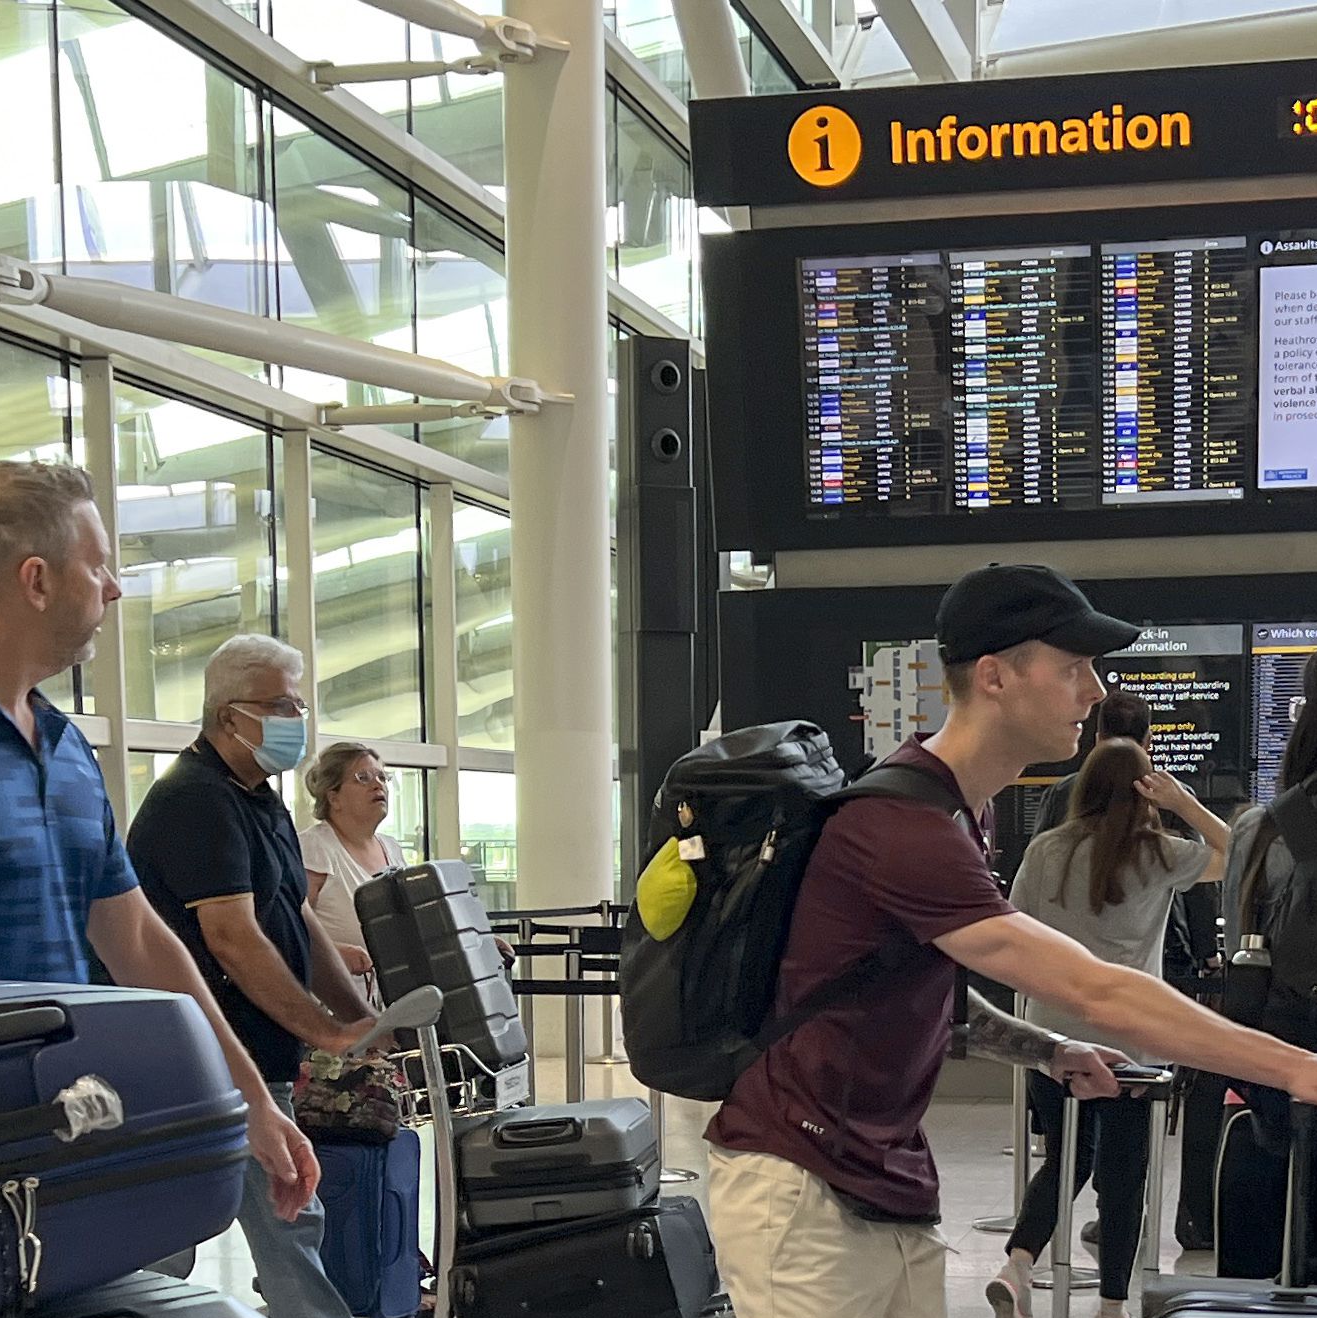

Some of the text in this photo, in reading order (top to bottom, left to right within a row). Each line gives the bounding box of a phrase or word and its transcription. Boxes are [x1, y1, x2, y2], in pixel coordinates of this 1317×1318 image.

[890, 104, 1192, 164] Information
[1274, 290, 1307, 301] Please
[1274, 304, 1303, 314] when
[1274, 317, 1292, 326] our
[1274, 350, 1280, 359] a
[1282, 347, 1314, 361] policy
[1273, 374, 1299, 384] form
[1300, 373, 1313, 383] of
[1273, 385, 1306, 397] verbal
[1273, 398, 1317, 409] violence
[1273, 412, 1283, 422] in
[1138, 628, 1169, 640] ck-in
[1270, 627, 1303, 639] Which
[1120, 671, 1196, 682] Your boarding card
[1120, 680, 1230, 692] Please collect your boarding
[1138, 691, 1220, 702] from any self-service
[1153, 702, 1176, 711] kiosk.
[1149, 721, 1196, 732] ggage only
[1163, 733, 1182, 742] your
[1183, 731, 1221, 742] boarding
[1154, 744, 1170, 753] you
[1170, 743, 1190, 751] have
[1191, 742, 1213, 751] hand
[1172, 753, 1189, 762] you
[1190, 753, 1204, 761] can
[1154, 763, 1198, 773] to Security.
[802, 1120, 825, 1135] BYLT
